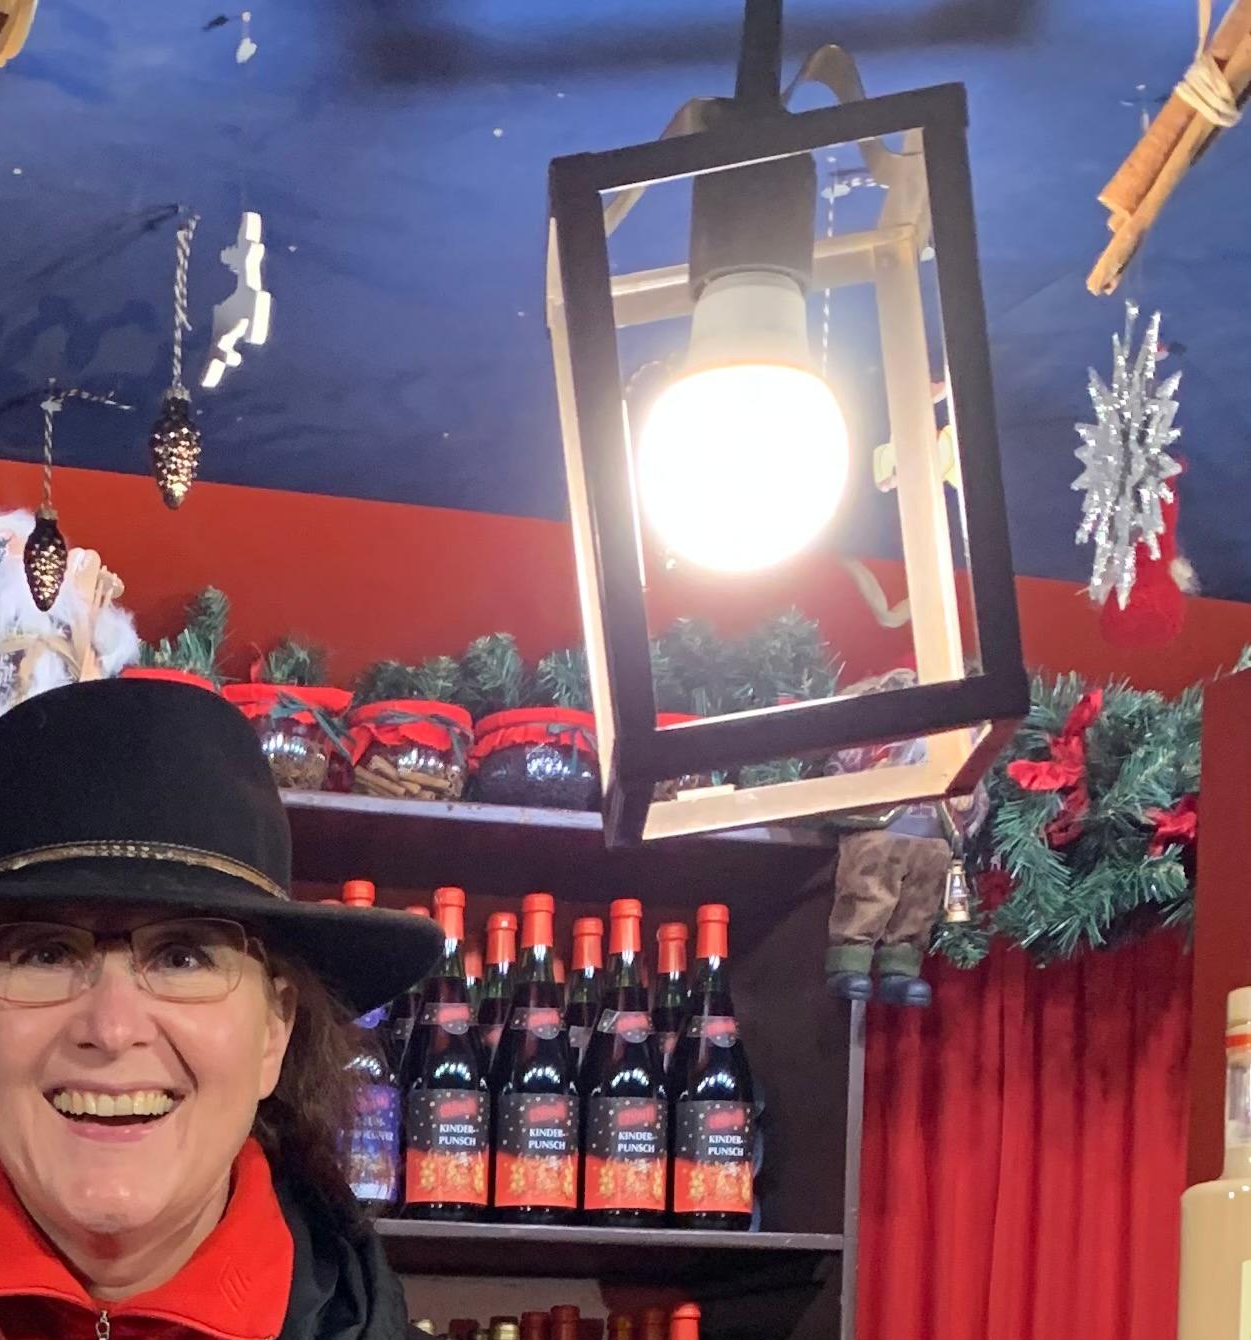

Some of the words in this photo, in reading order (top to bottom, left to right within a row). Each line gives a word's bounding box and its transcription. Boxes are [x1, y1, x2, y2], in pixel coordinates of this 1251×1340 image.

[439, 1136, 476, 1147] PUNSCH
[528, 1139, 566, 1150] PUNSCH
[617, 1143, 655, 1154] PUNSCH
[708, 1146, 744, 1157] PUNSCH
